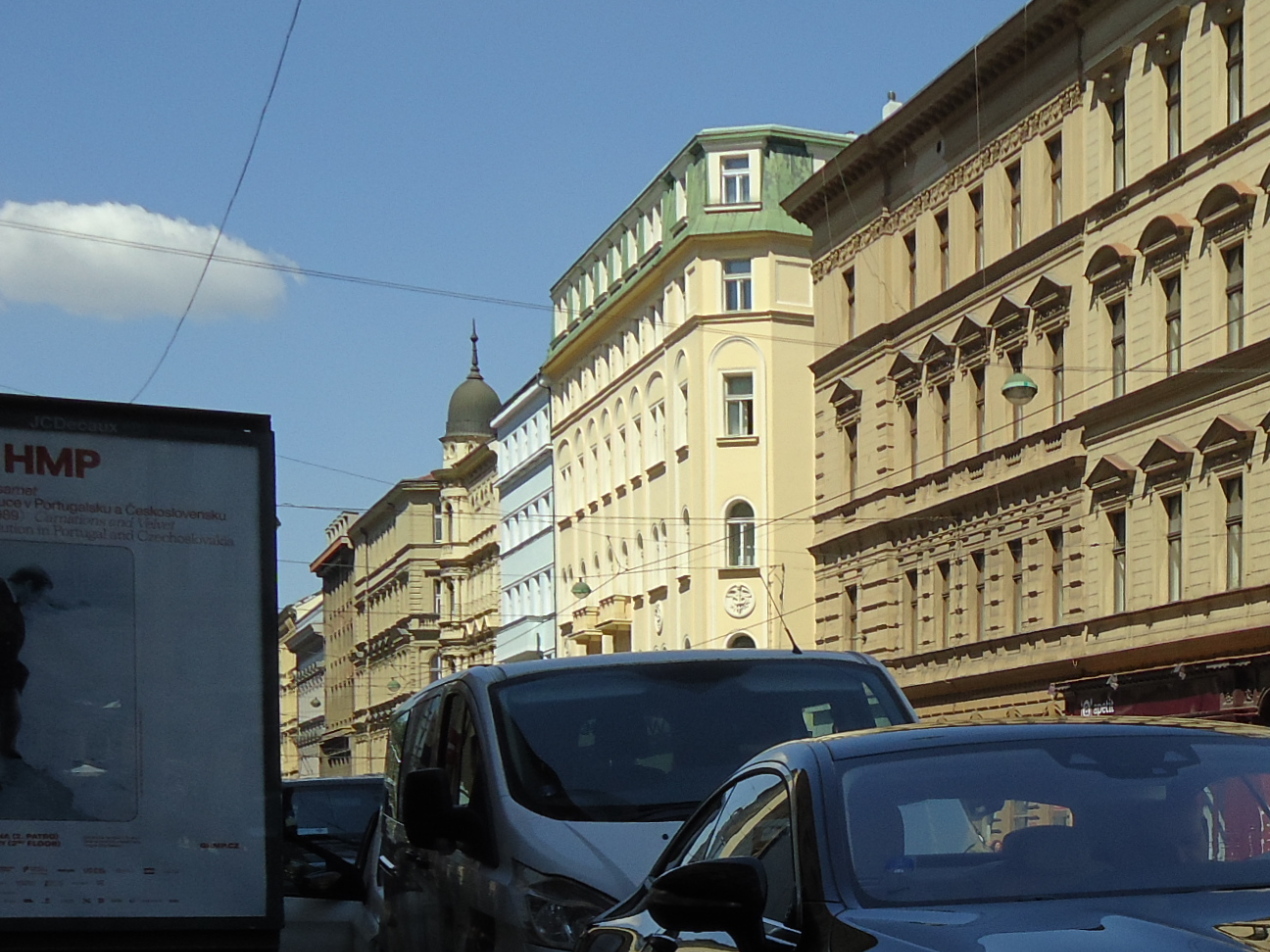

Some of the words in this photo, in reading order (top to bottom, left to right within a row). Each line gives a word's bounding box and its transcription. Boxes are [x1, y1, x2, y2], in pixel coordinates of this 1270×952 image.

[30, 416, 118, 433] JCDecaux
[4, 443, 101, 478] HMP
[34, 498, 111, 515] Portugalsku
[114, 506, 122, 515] a
[125, 502, 227, 521] Československu
[54, 525, 107, 541] Portugal
[110, 530, 134, 541] and
